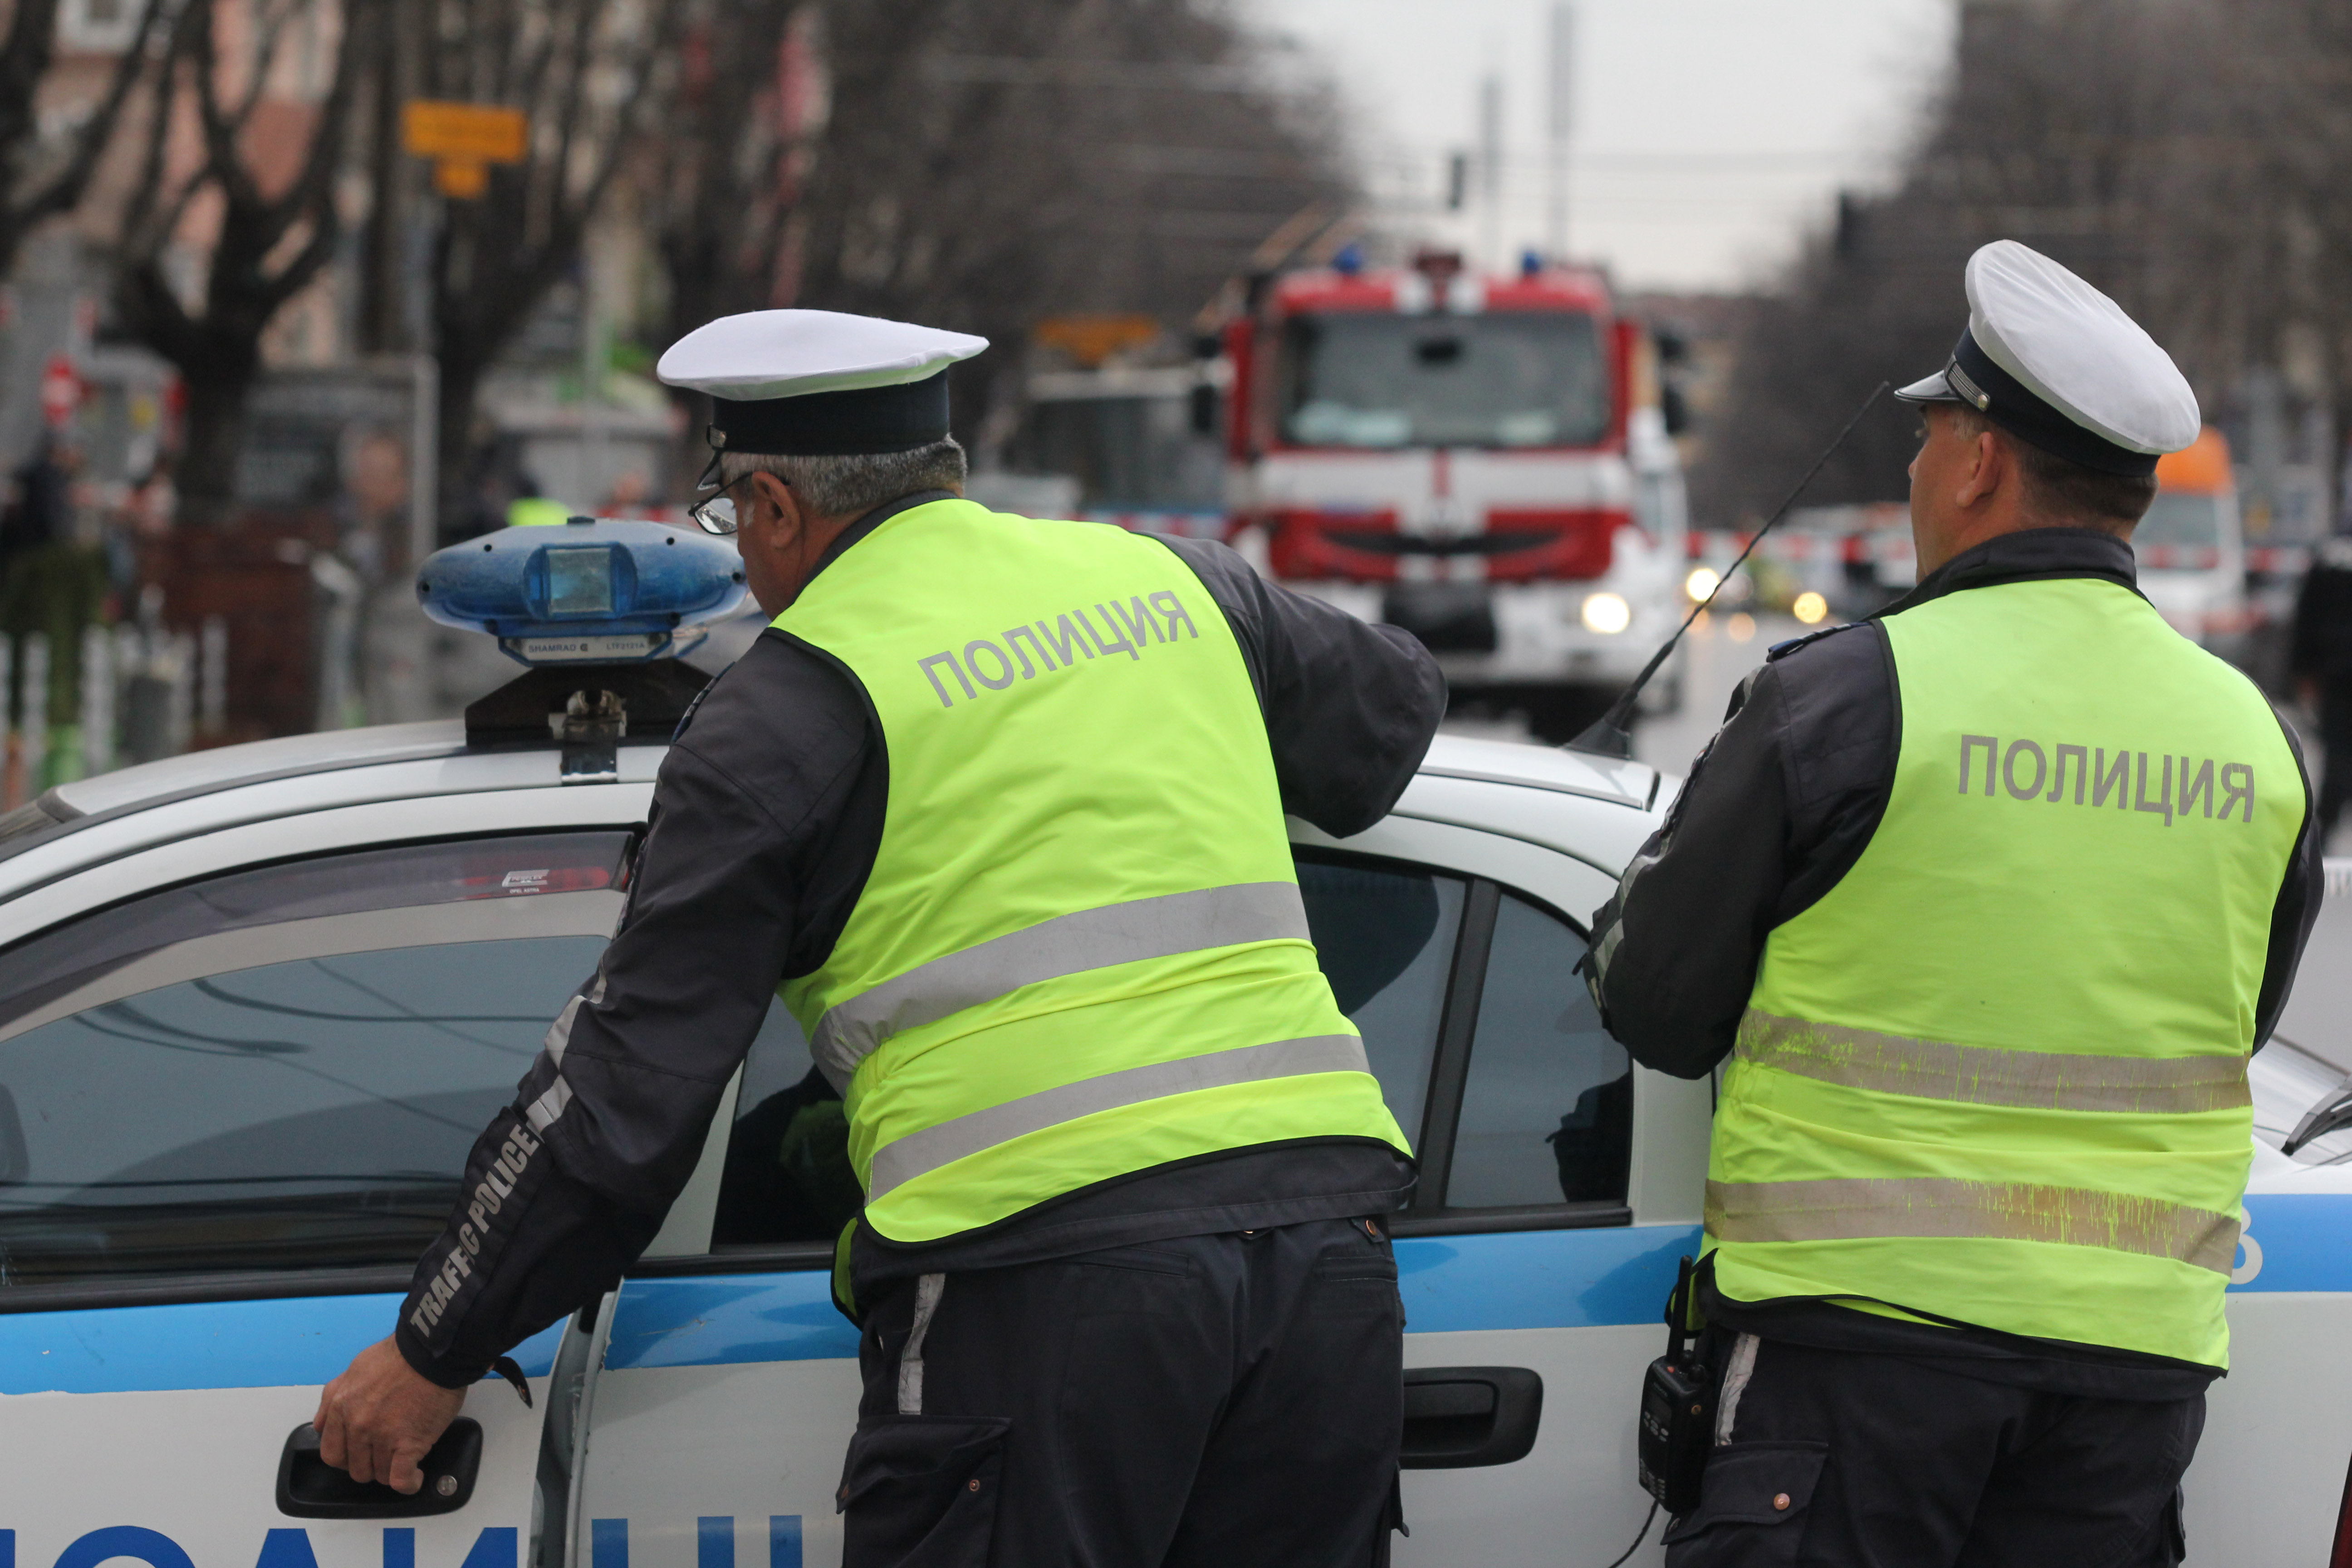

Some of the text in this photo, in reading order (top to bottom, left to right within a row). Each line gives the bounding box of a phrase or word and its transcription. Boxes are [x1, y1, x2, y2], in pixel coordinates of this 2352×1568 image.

[529, 644, 577, 652] SHAMRAD
[917, 590, 1199, 707] ПОЛИЦИЯ
[1959, 734, 2255, 827] ПОЛИЦИЯ
[468, 1124, 539, 1234] POLICE
